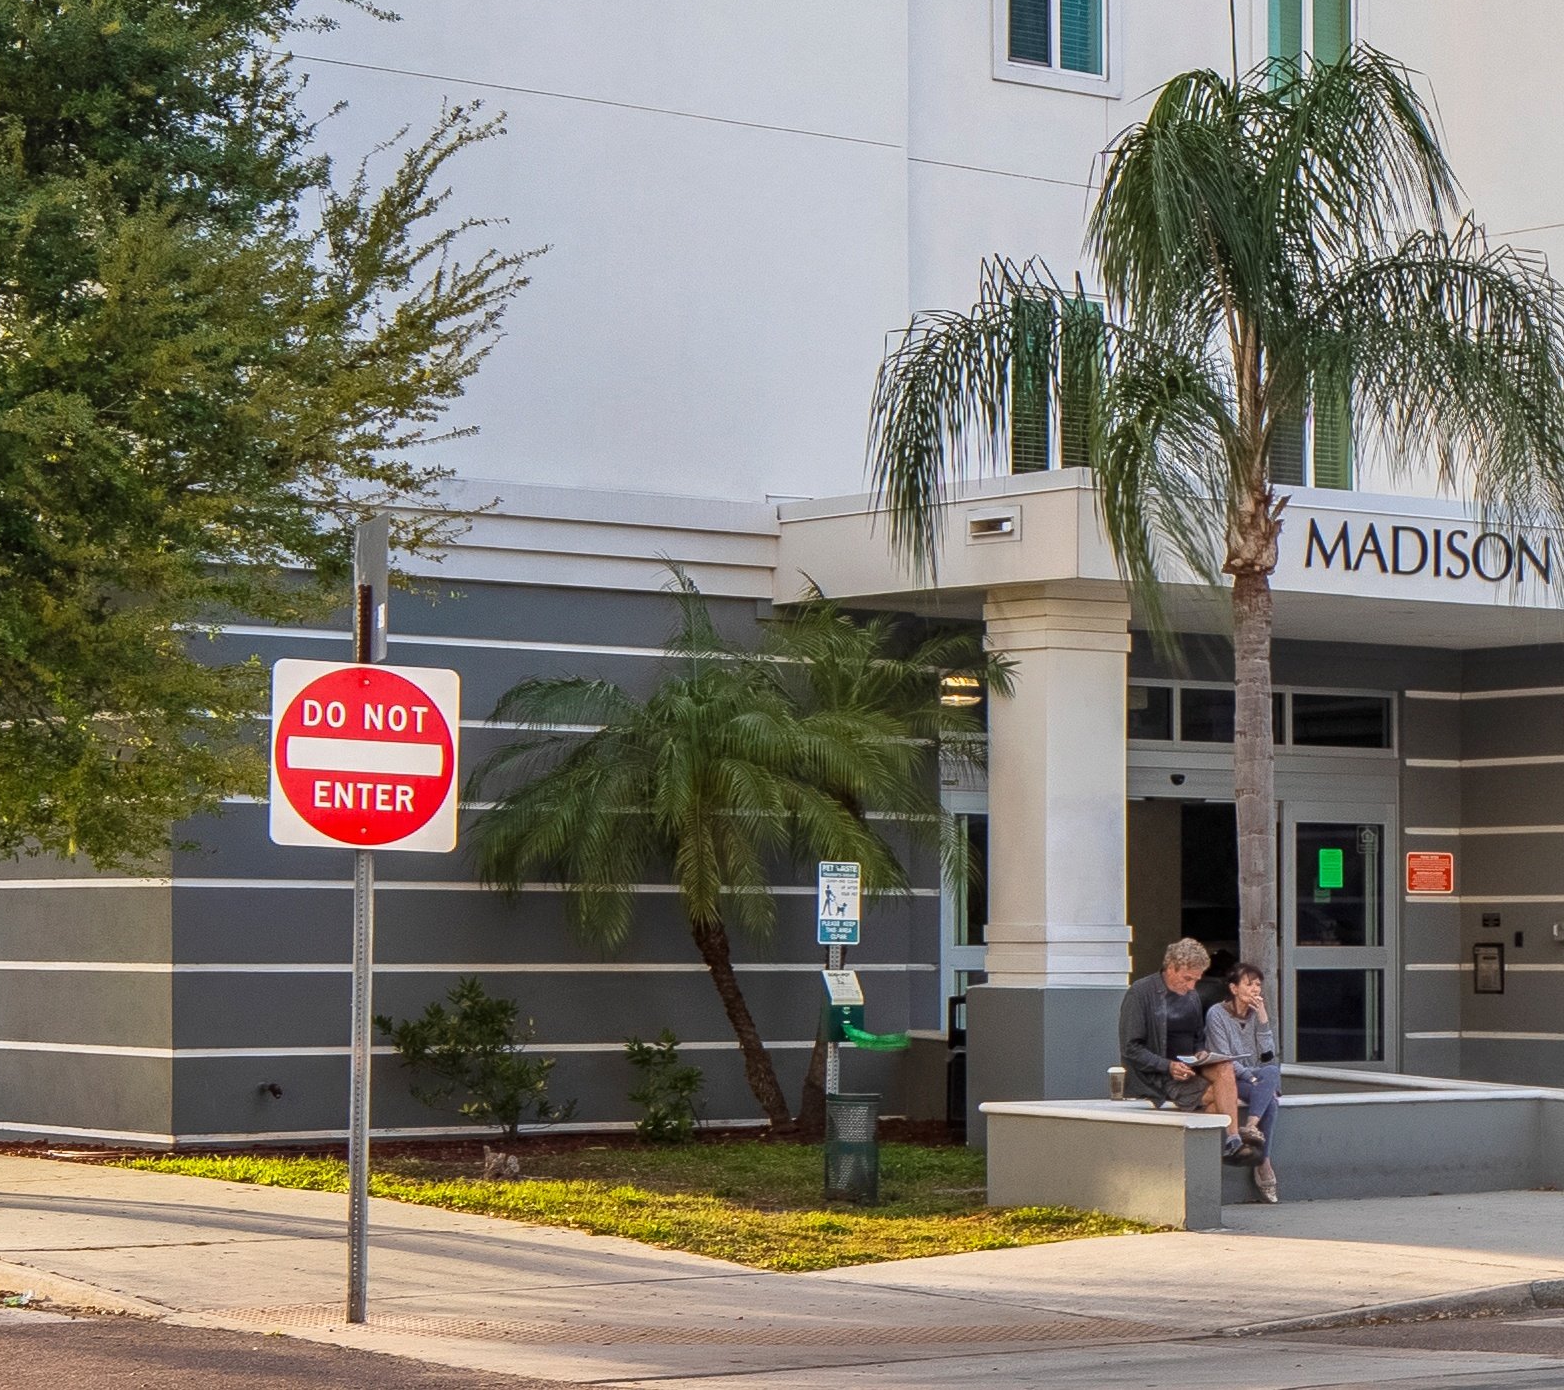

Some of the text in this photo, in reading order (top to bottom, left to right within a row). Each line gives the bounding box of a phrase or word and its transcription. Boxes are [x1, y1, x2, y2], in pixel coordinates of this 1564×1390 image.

[1304, 518, 1551, 585] MADISON
[303, 699, 429, 732] DO NOT
[313, 780, 415, 813] ENTER
